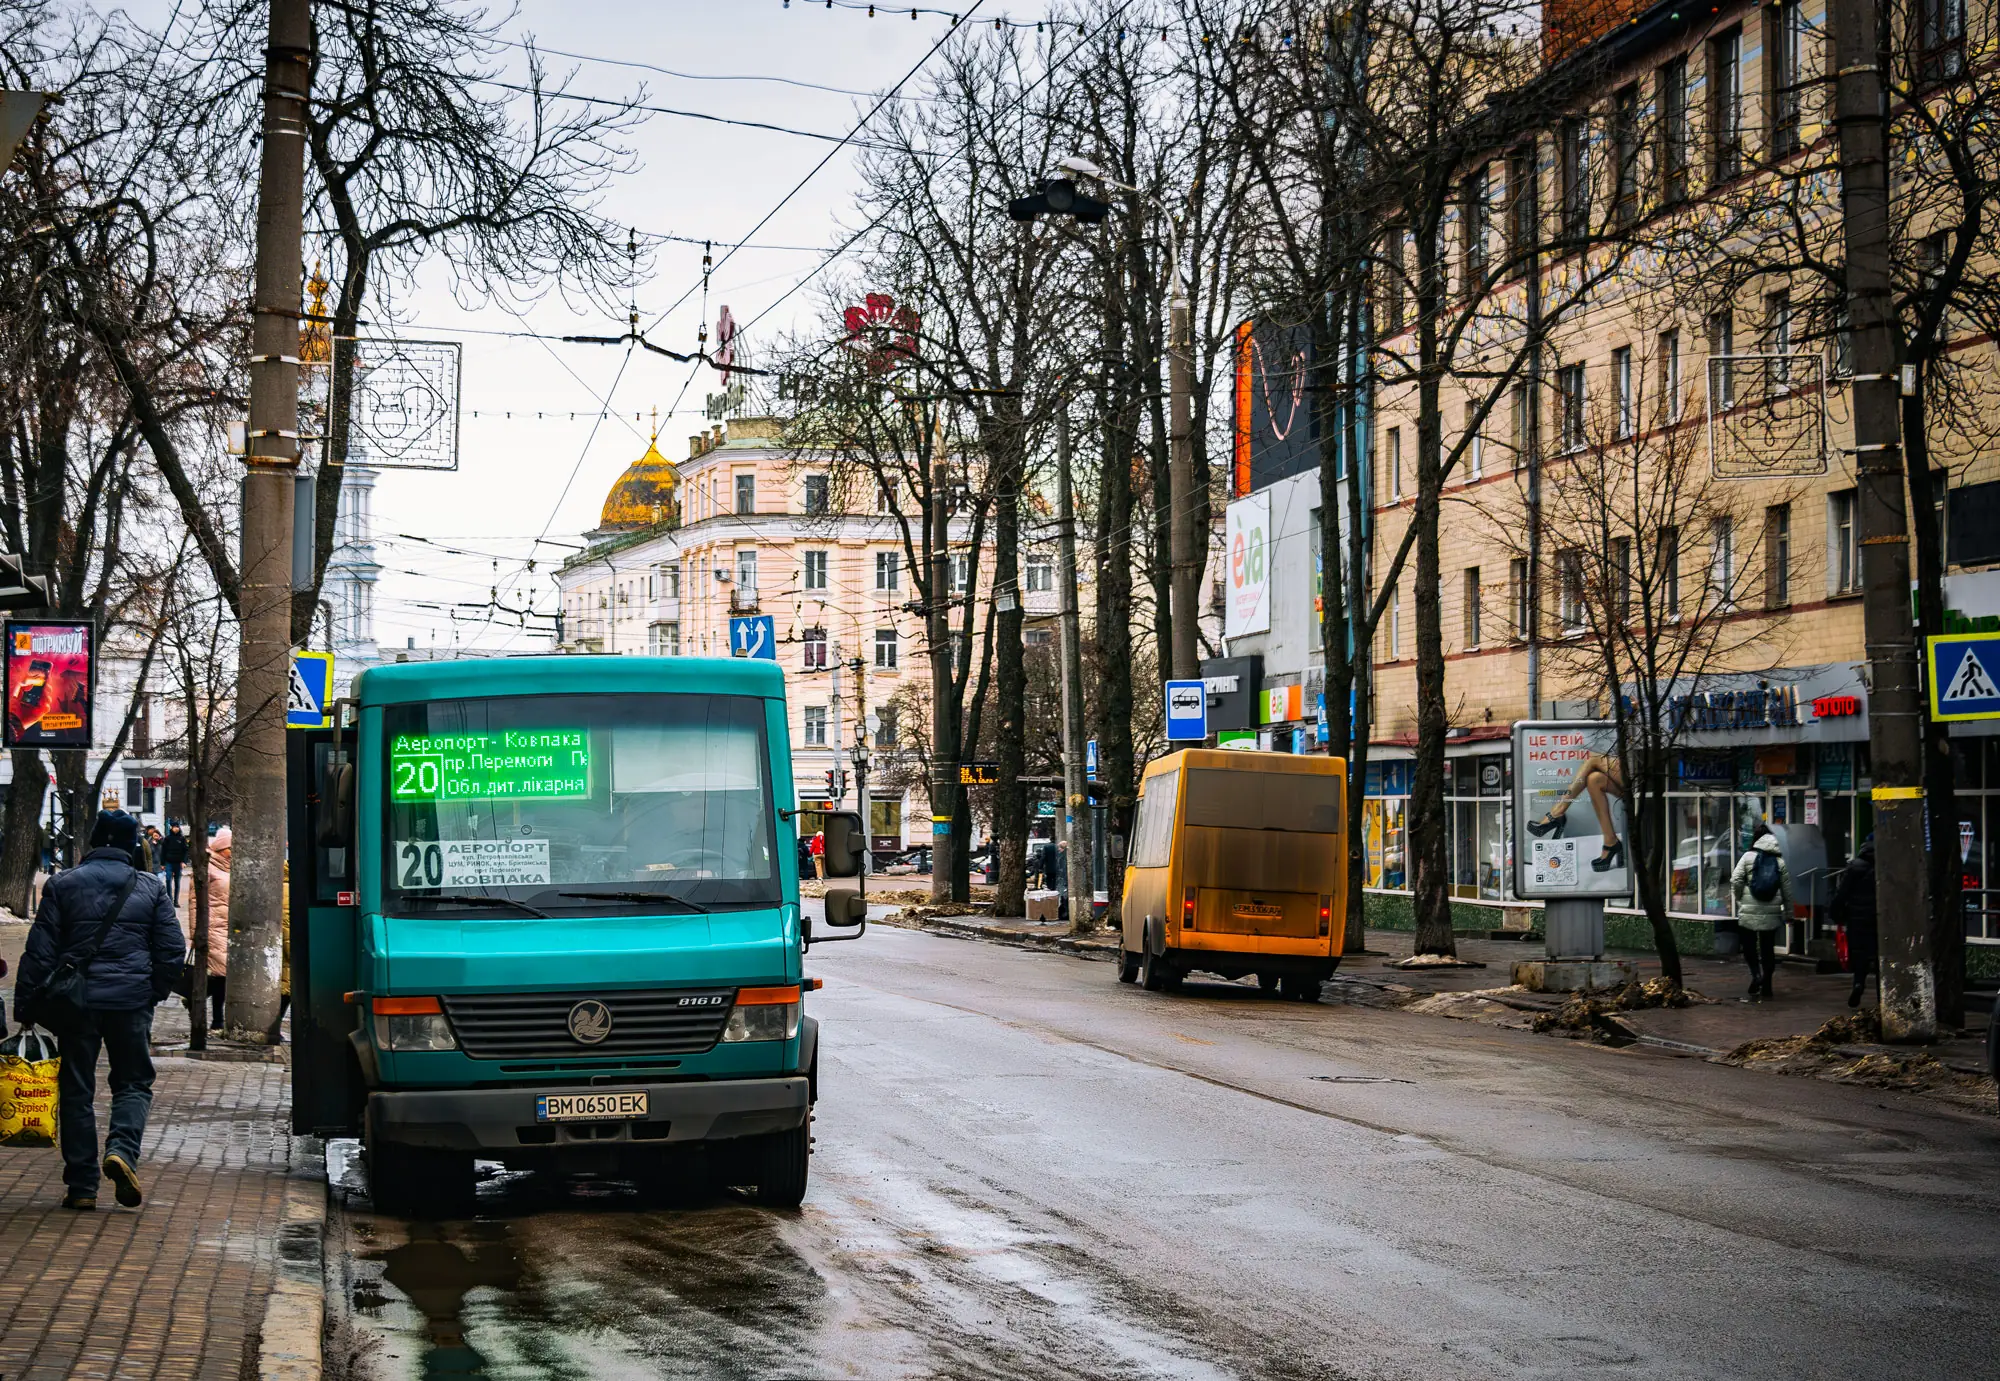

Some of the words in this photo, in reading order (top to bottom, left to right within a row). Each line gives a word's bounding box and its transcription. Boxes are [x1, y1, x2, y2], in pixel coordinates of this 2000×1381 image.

[505, 732, 580, 748] Ковпака
[1529, 735, 1547, 747] ЦЕ
[1552, 732, 1584, 745] ТВІЙ
[396, 761, 438, 794] 20
[448, 843, 547, 853] АЕРОПОРТ
[402, 844, 442, 887] 20
[451, 874, 545, 885] КОВПАКА
[679, 998, 708, 1006] 816
[711, 996, 722, 1005] D
[548, 1098, 573, 1115] BM
[576, 1096, 617, 1113] 0650
[620, 1095, 645, 1112] EK
